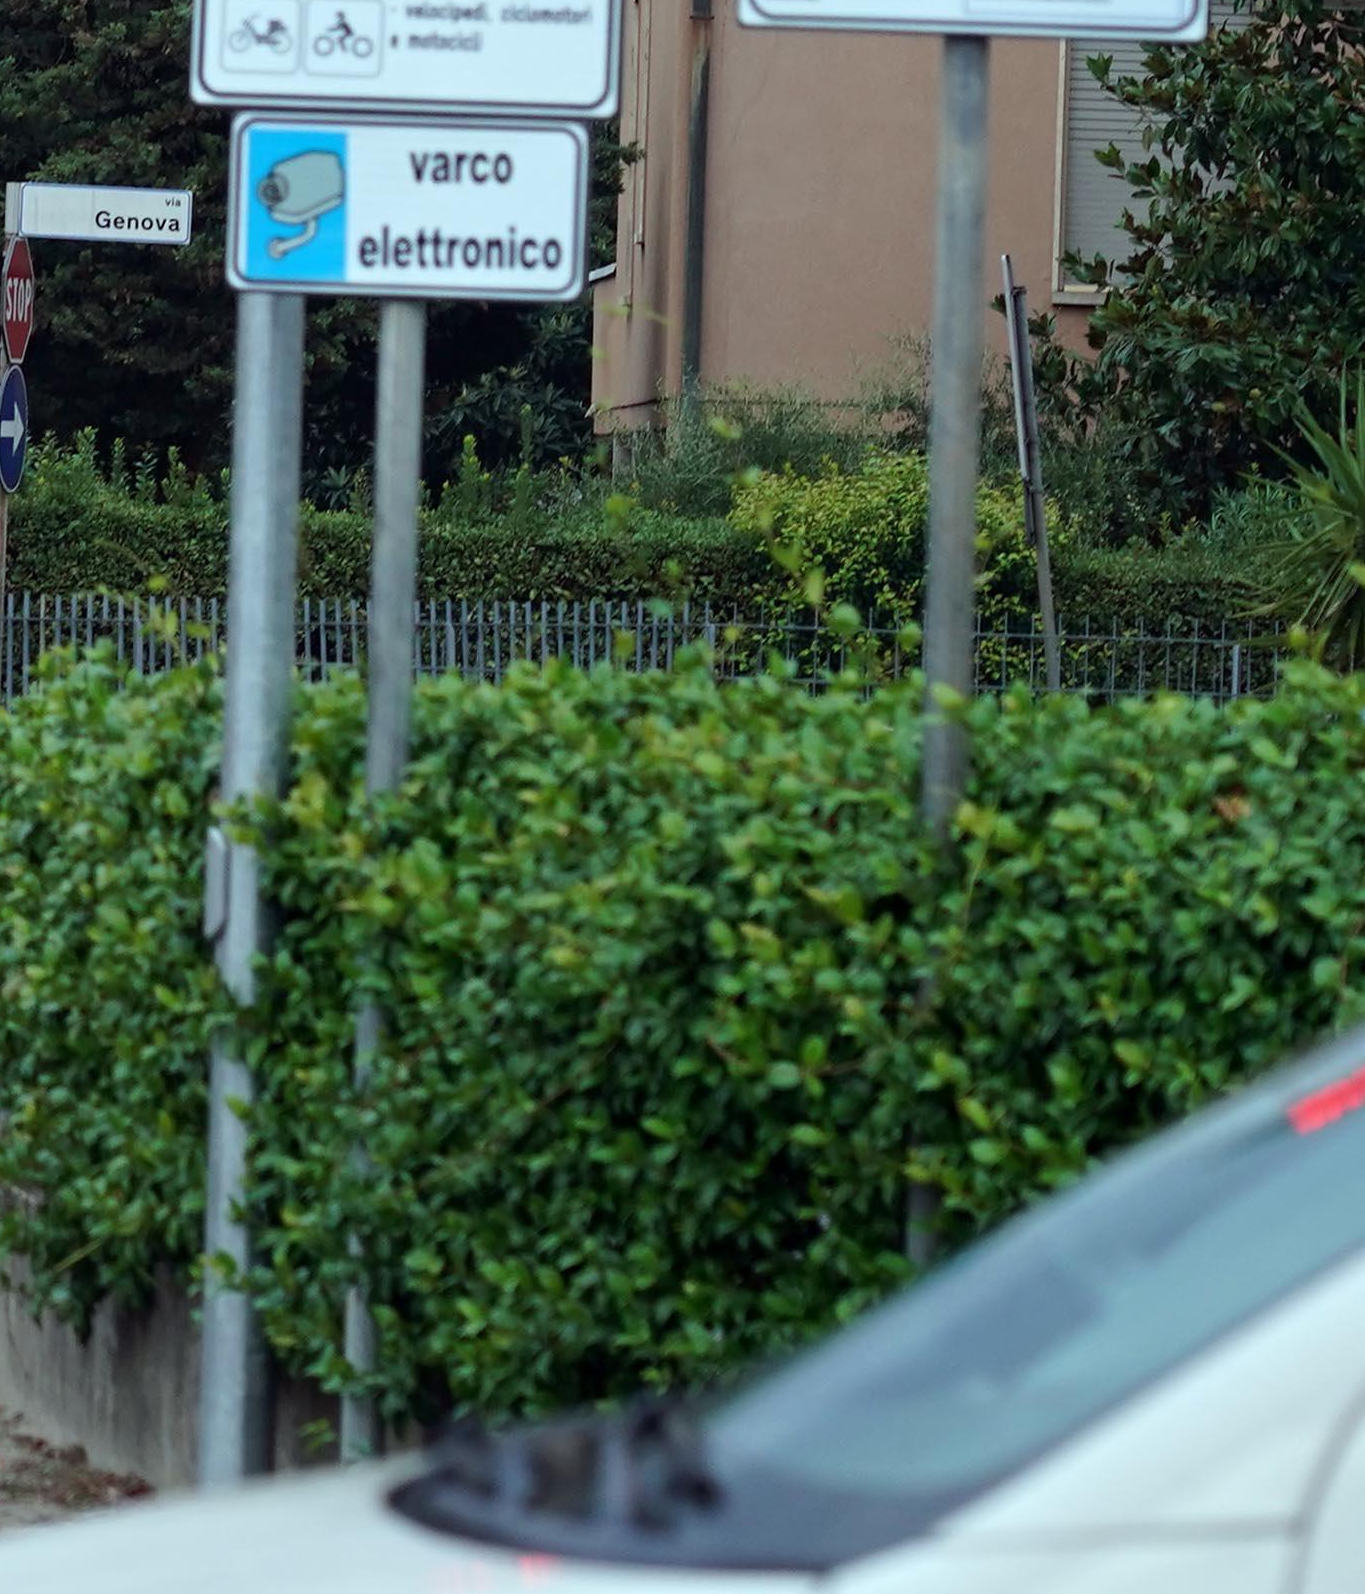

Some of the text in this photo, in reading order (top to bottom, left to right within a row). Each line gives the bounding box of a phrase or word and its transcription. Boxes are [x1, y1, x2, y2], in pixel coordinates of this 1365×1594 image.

[409, 151, 514, 185] varco
[164, 196, 182, 207] via
[94, 210, 181, 232] Genova
[357, 225, 563, 271] elettronico
[6, 276, 32, 323] STOP
